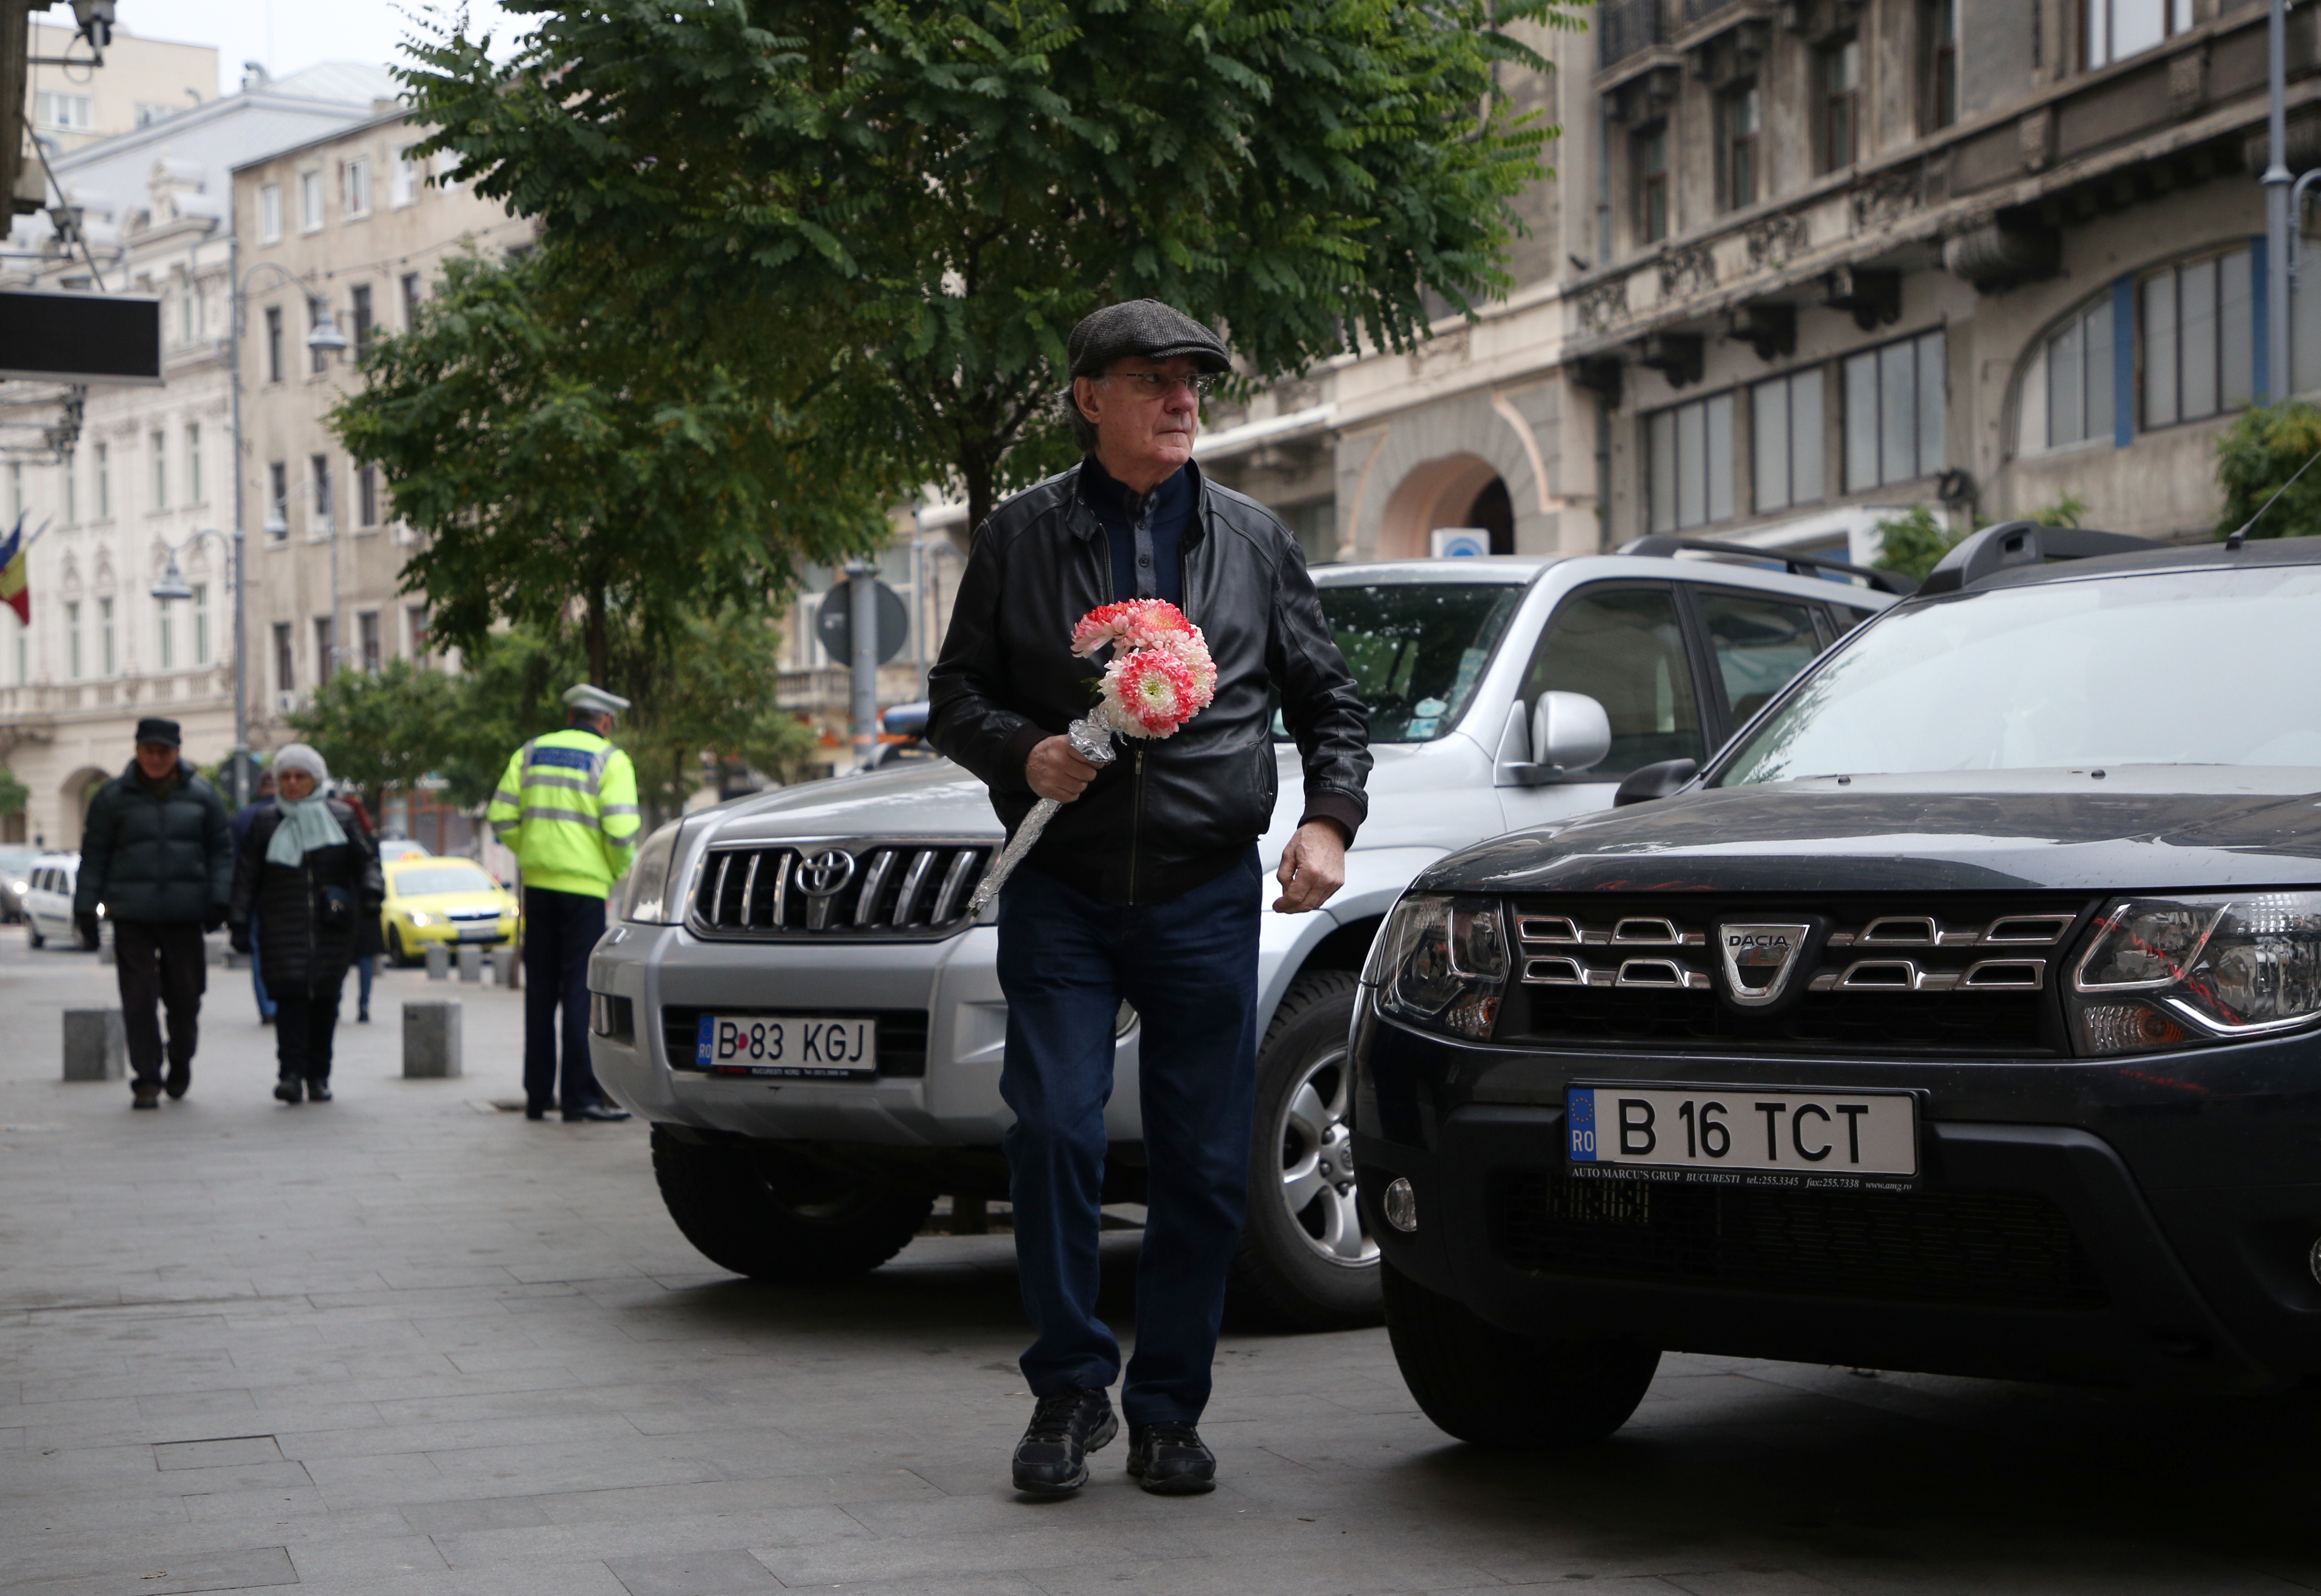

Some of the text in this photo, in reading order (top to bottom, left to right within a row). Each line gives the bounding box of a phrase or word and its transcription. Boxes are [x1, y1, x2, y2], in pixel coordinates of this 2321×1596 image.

[1729, 935, 1788, 946] DACIA
[699, 1044, 711, 1058] RO
[718, 1022, 863, 1061] B 83 KGJ
[1573, 1130, 1594, 1152] RO
[1619, 1099, 1869, 1163] B 16 TCT
[1572, 1168, 1912, 1192] AUTO MARCU'S GRUP BUCURESTI tel.:255.3345 fax:255.7338 www.amg.ro
